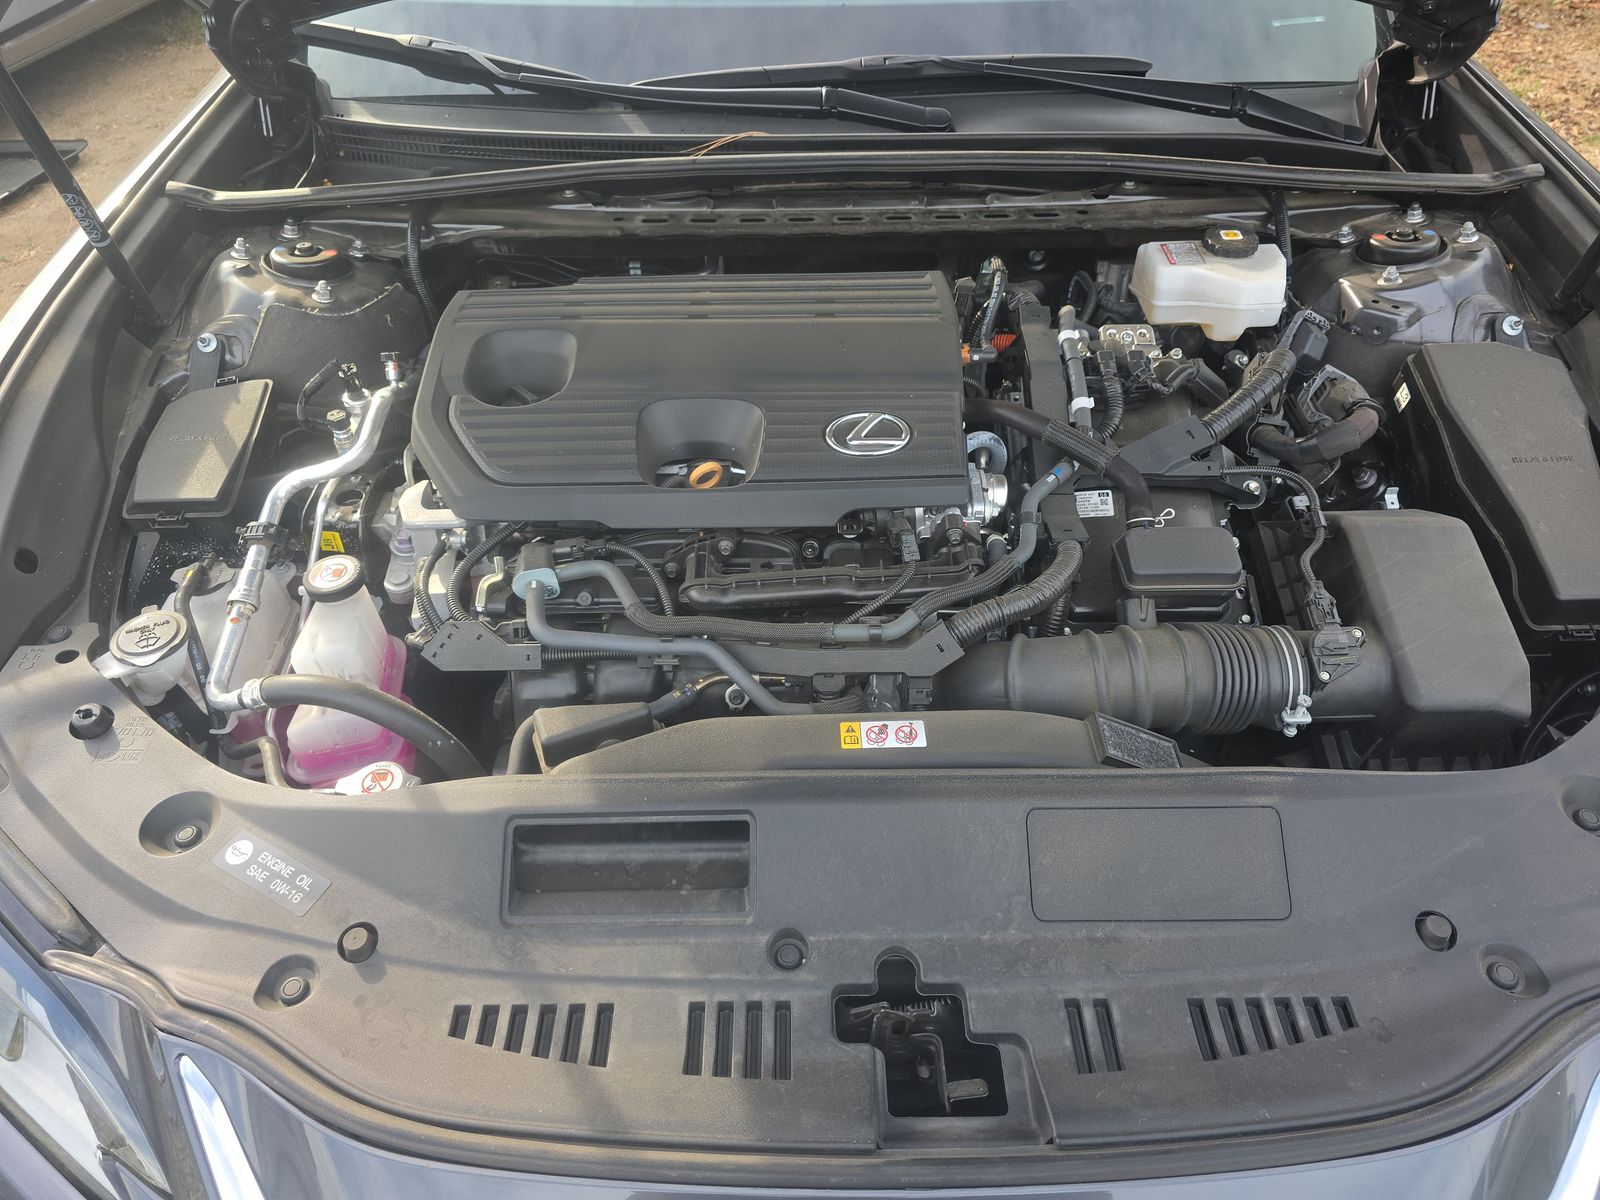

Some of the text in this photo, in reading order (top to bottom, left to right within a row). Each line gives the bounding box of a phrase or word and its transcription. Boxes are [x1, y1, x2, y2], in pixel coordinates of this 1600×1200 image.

[246, 864, 303, 903] SAE 0W-16
[257, 851, 313, 891] ENGINE OIL
